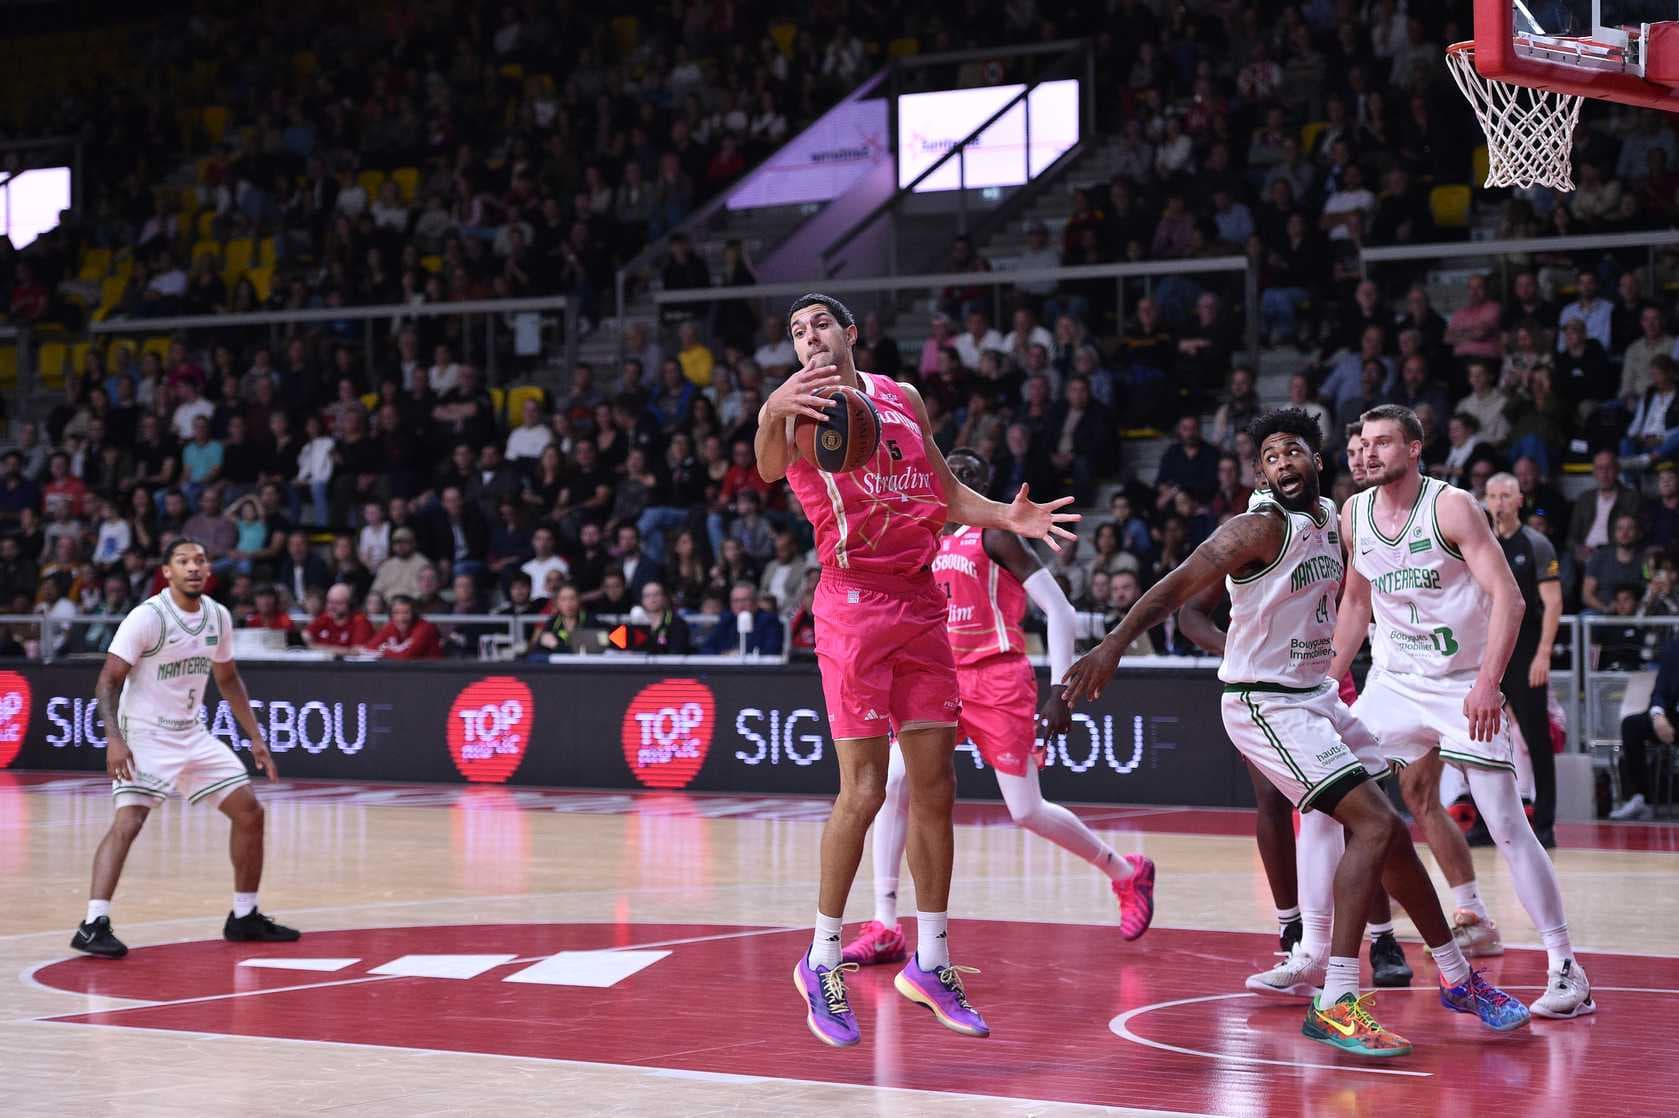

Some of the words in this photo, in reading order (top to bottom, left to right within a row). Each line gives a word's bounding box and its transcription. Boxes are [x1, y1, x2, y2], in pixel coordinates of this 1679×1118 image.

[887, 439, 902, 460] 5
[1316, 594, 1329, 623] 24
[186, 688, 196, 710] 5
[458, 699, 523, 742] TOP
[634, 702, 705, 746] TOP
[735, 708, 823, 765] SIG
